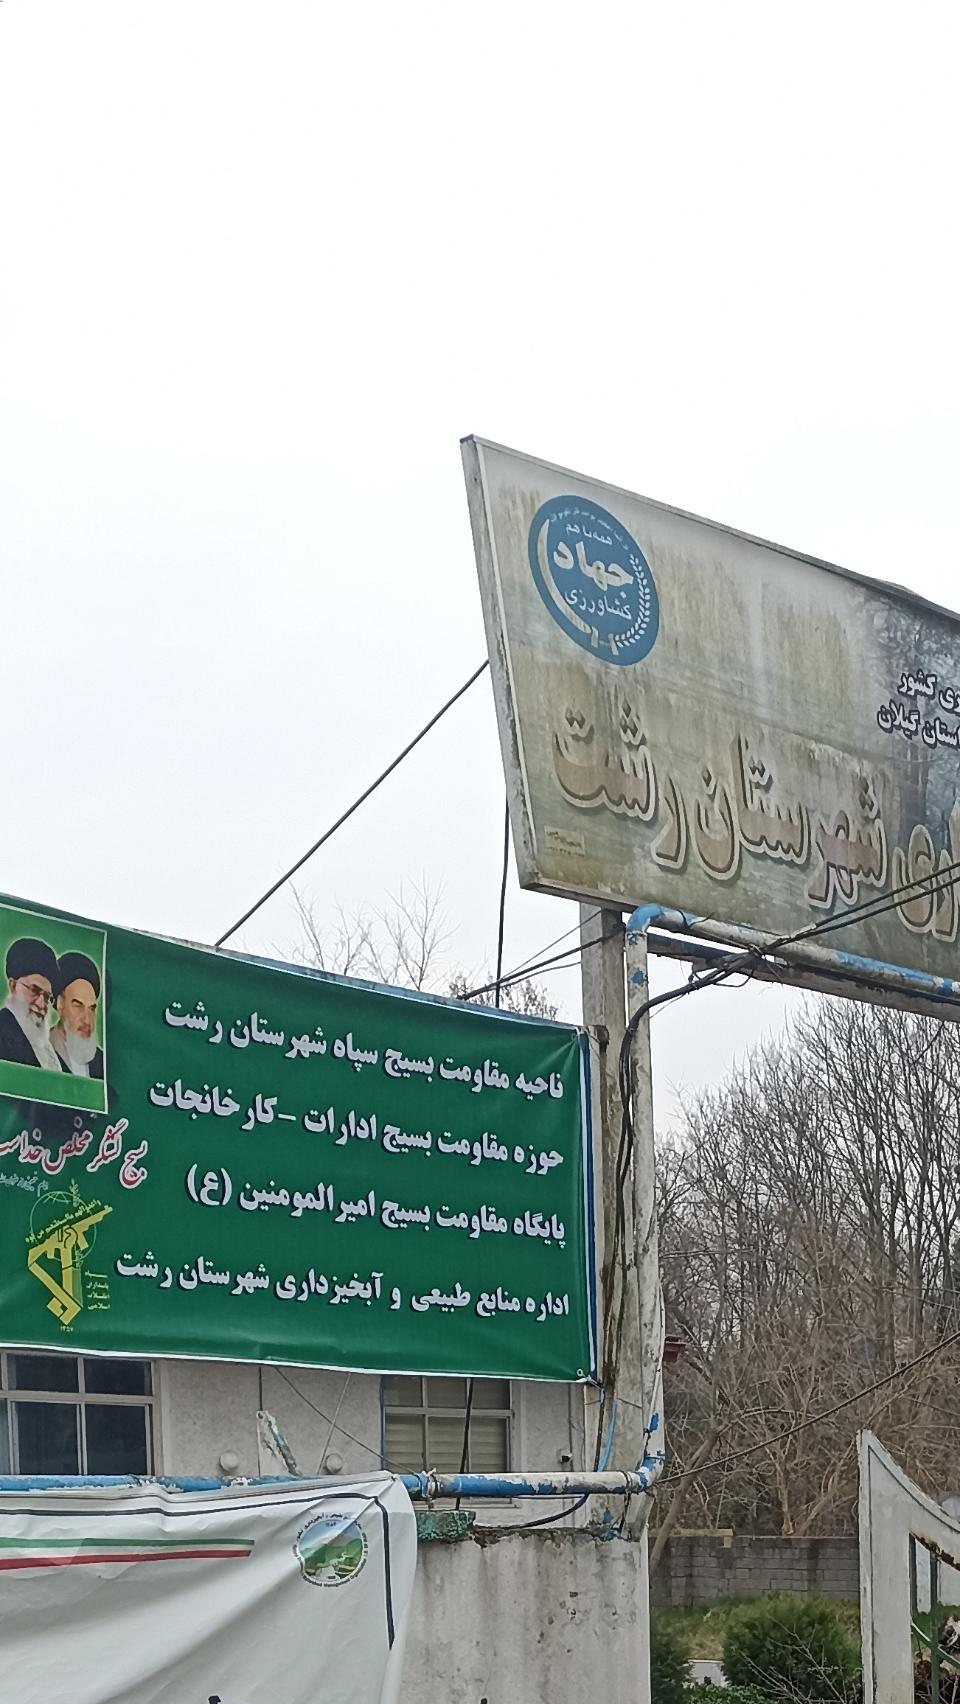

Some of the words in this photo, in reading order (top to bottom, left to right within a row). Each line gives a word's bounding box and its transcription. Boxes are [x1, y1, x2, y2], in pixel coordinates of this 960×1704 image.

[553, 541, 634, 592] جهاد
[565, 588, 632, 620] کشاورزی
[898, 669, 937, 698] کشور
[877, 700, 920, 739] گیلان
[553, 702, 688, 870] رشت
[692, 732, 887, 909] شهرستان
[165, 1001, 223, 1043] رشت
[230, 1012, 327, 1058] شهرستان
[333, 1032, 379, 1072] سپاه
[384, 1049, 434, 1083] بسیج
[439, 1057, 510, 1092] مقاومت
[515, 1072, 564, 1100] ناحیه
[304, 1106, 376, 1145] ادارات
[382, 1124, 432, 1157] بسیج
[437, 1131, 509, 1166] مقاومت
[513, 1144, 564, 1175] حوزه
[187, 1163, 232, 1206] (ع)
[381, 1200, 431, 1231] بسیج
[436, 1204, 508, 1238] مقاومت
[513, 1211, 566, 1249] پایگاه
[116, 1251, 173, 1288] رشت
[179, 1256, 270, 1294] شهرستان
[276, 1269, 383, 1305] آبخیزداری
[390, 1287, 401, 1309] و
[411, 1282, 471, 1312] طبیعی
[476, 1287, 521, 1316] منابع
[525, 1292, 569, 1321] اداره
